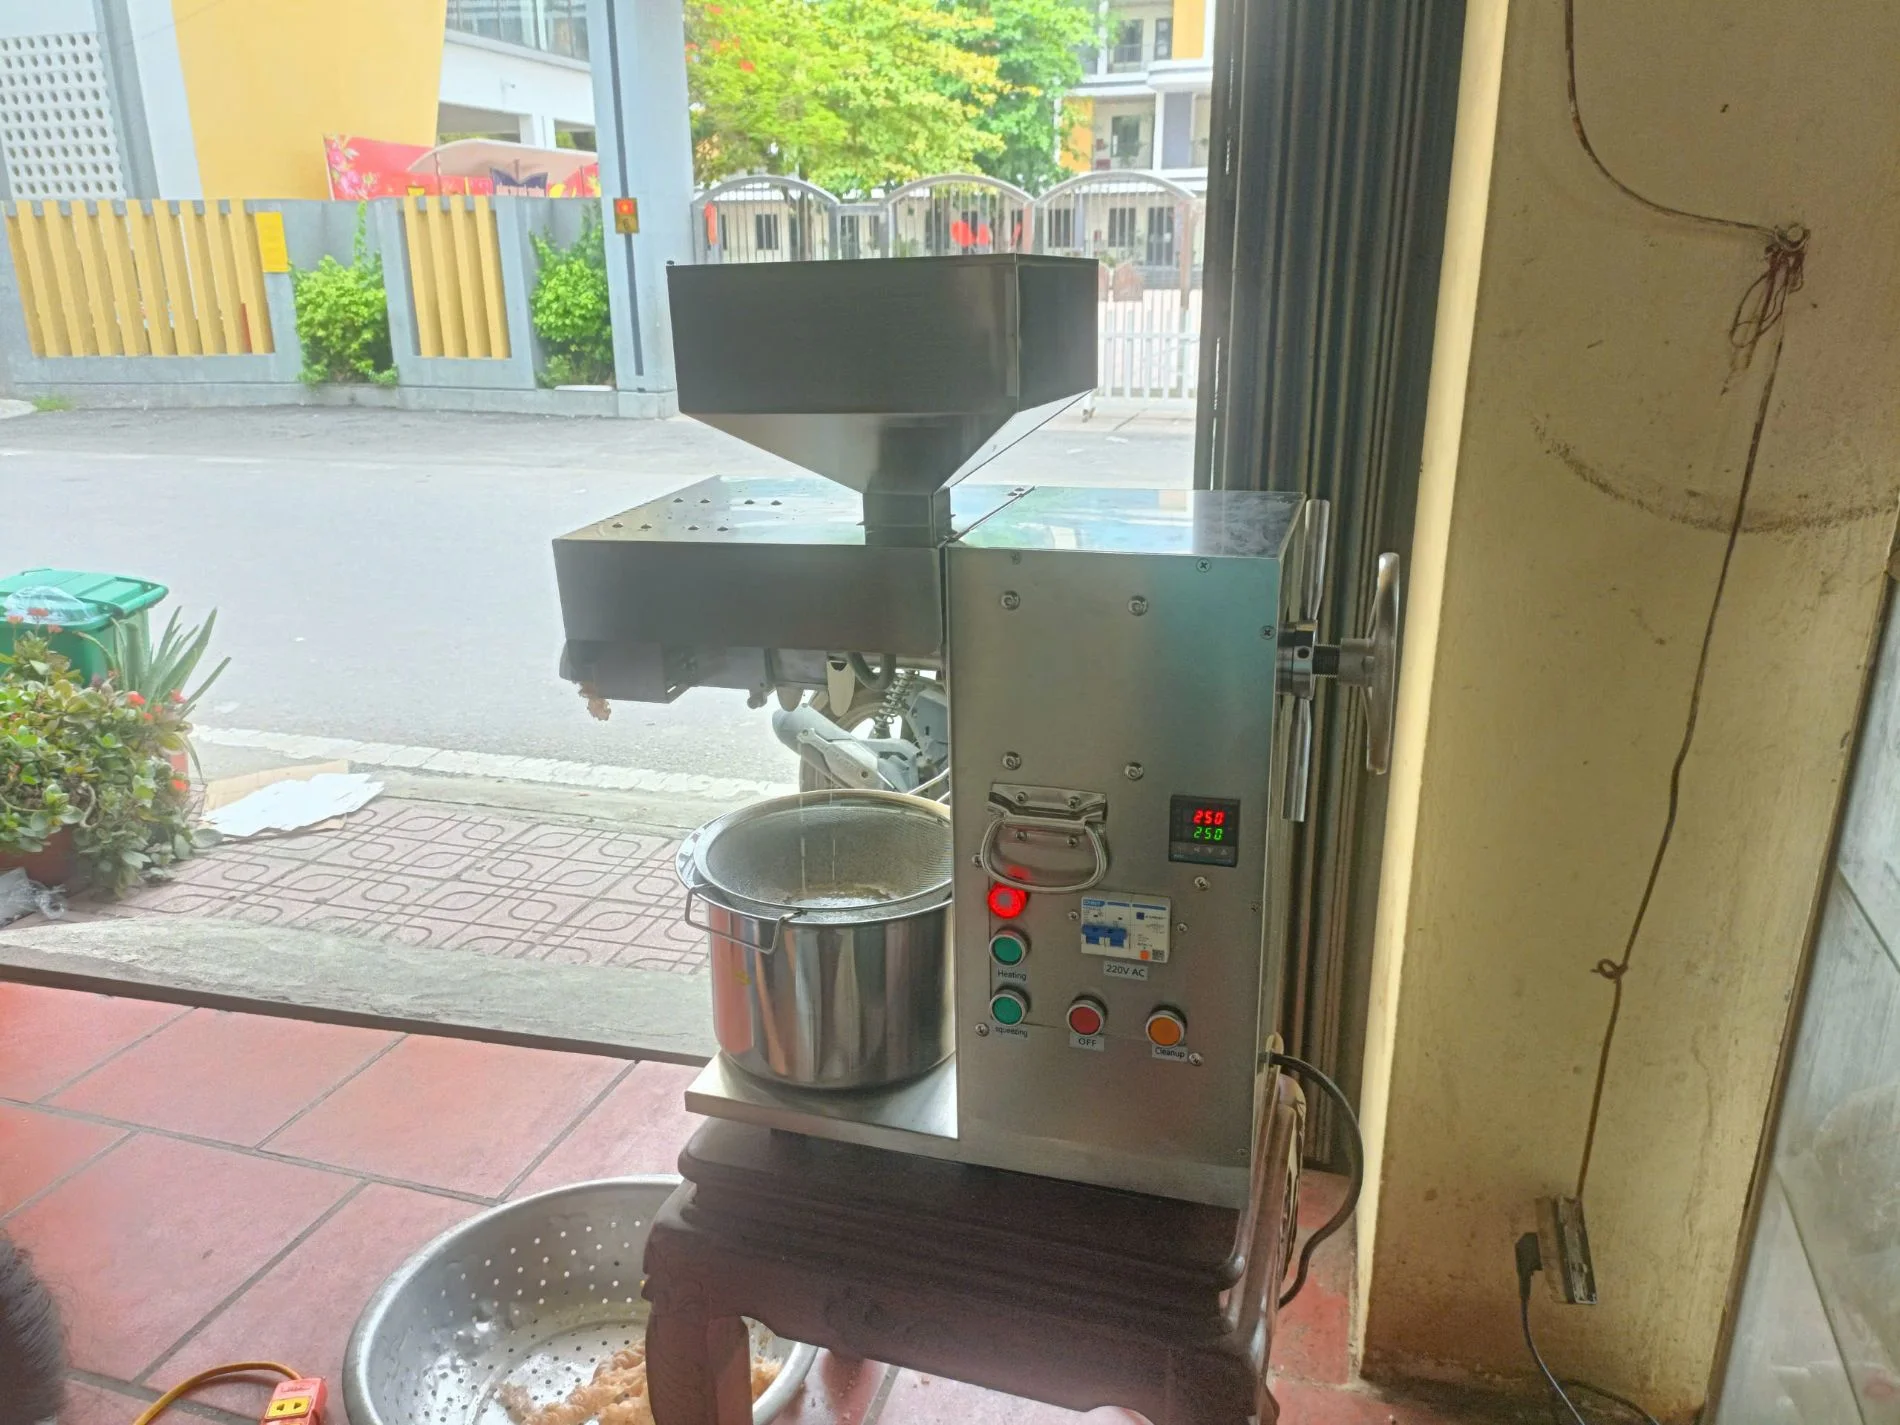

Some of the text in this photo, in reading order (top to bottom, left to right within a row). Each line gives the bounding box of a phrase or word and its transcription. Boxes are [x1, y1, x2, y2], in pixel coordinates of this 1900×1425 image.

[1193, 808, 1225, 826] 250
[1193, 826, 1223, 841] 250
[997, 968, 1027, 981] Heating
[1106, 964, 1145, 977] 220V AC
[1078, 1037, 1097, 1048] OFF
[1154, 1047, 1185, 1059] Cleanup
